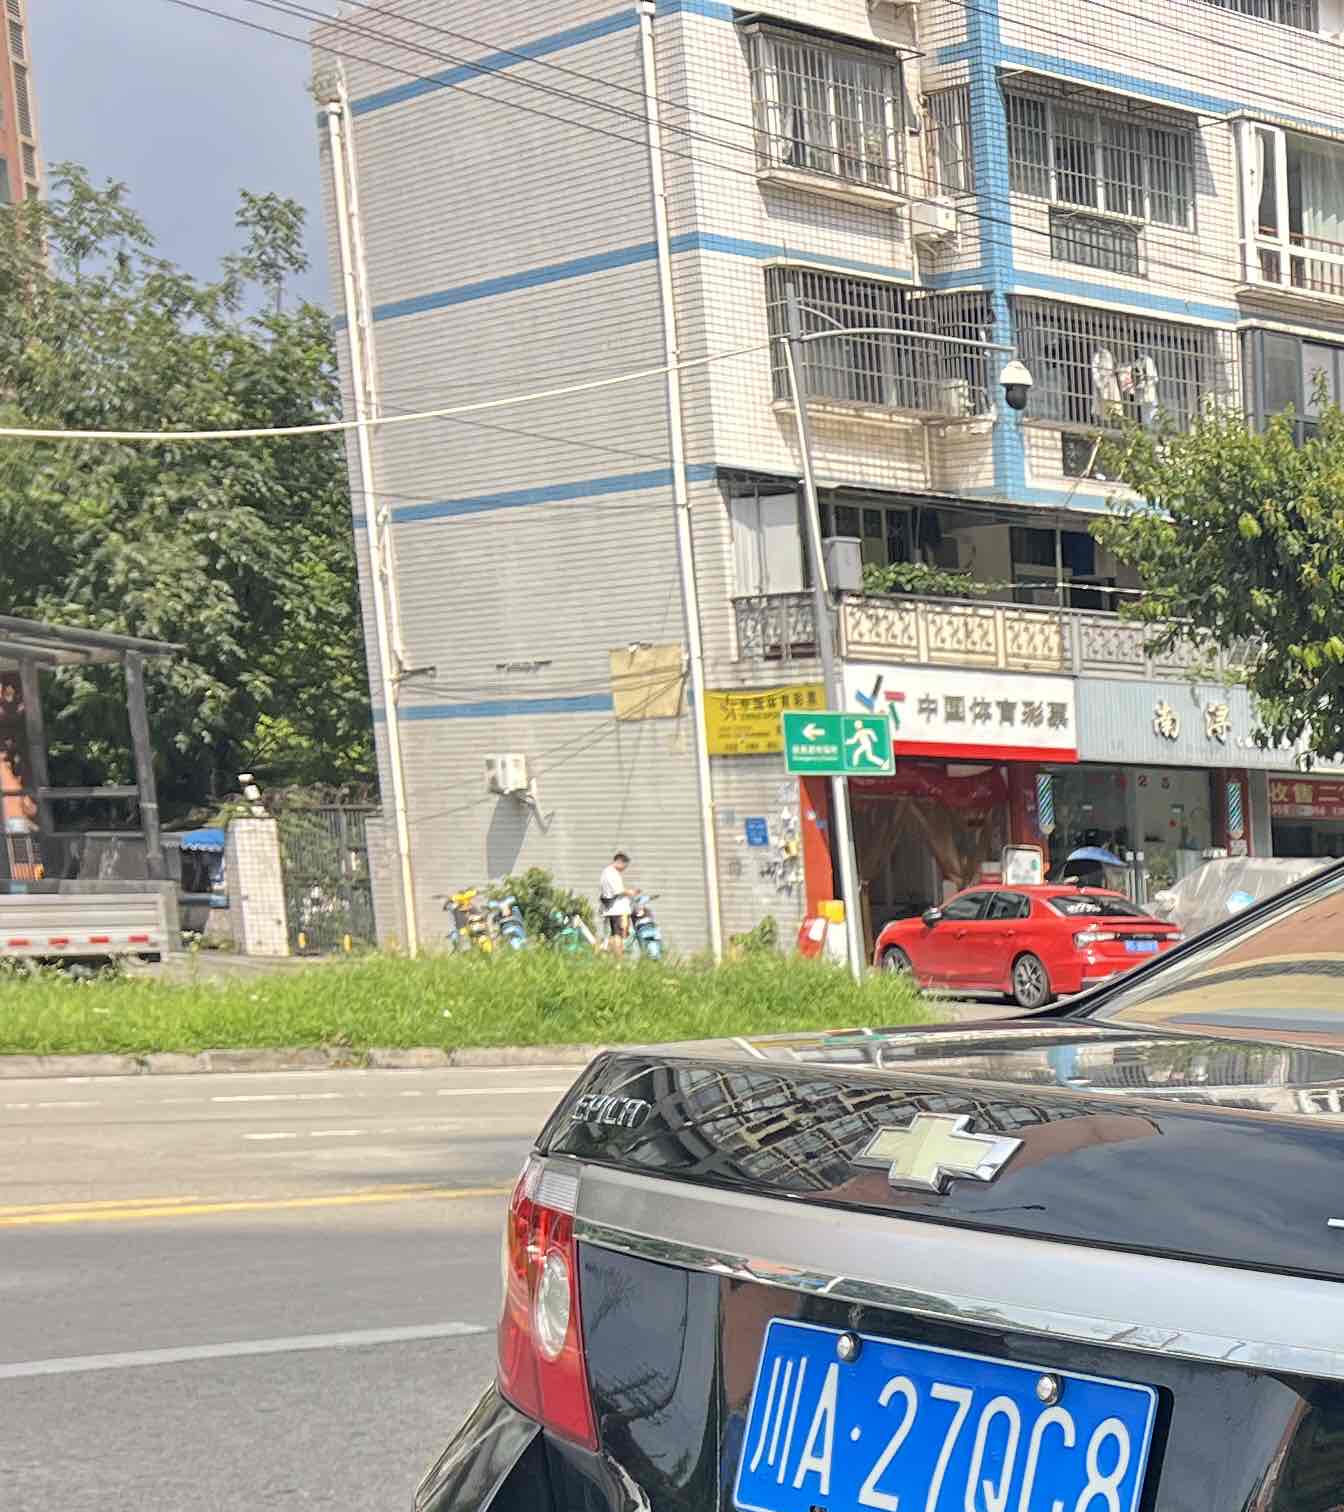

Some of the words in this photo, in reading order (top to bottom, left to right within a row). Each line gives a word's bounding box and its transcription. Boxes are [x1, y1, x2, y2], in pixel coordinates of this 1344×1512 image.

[917, 692, 1069, 730] 中国体育彩票
